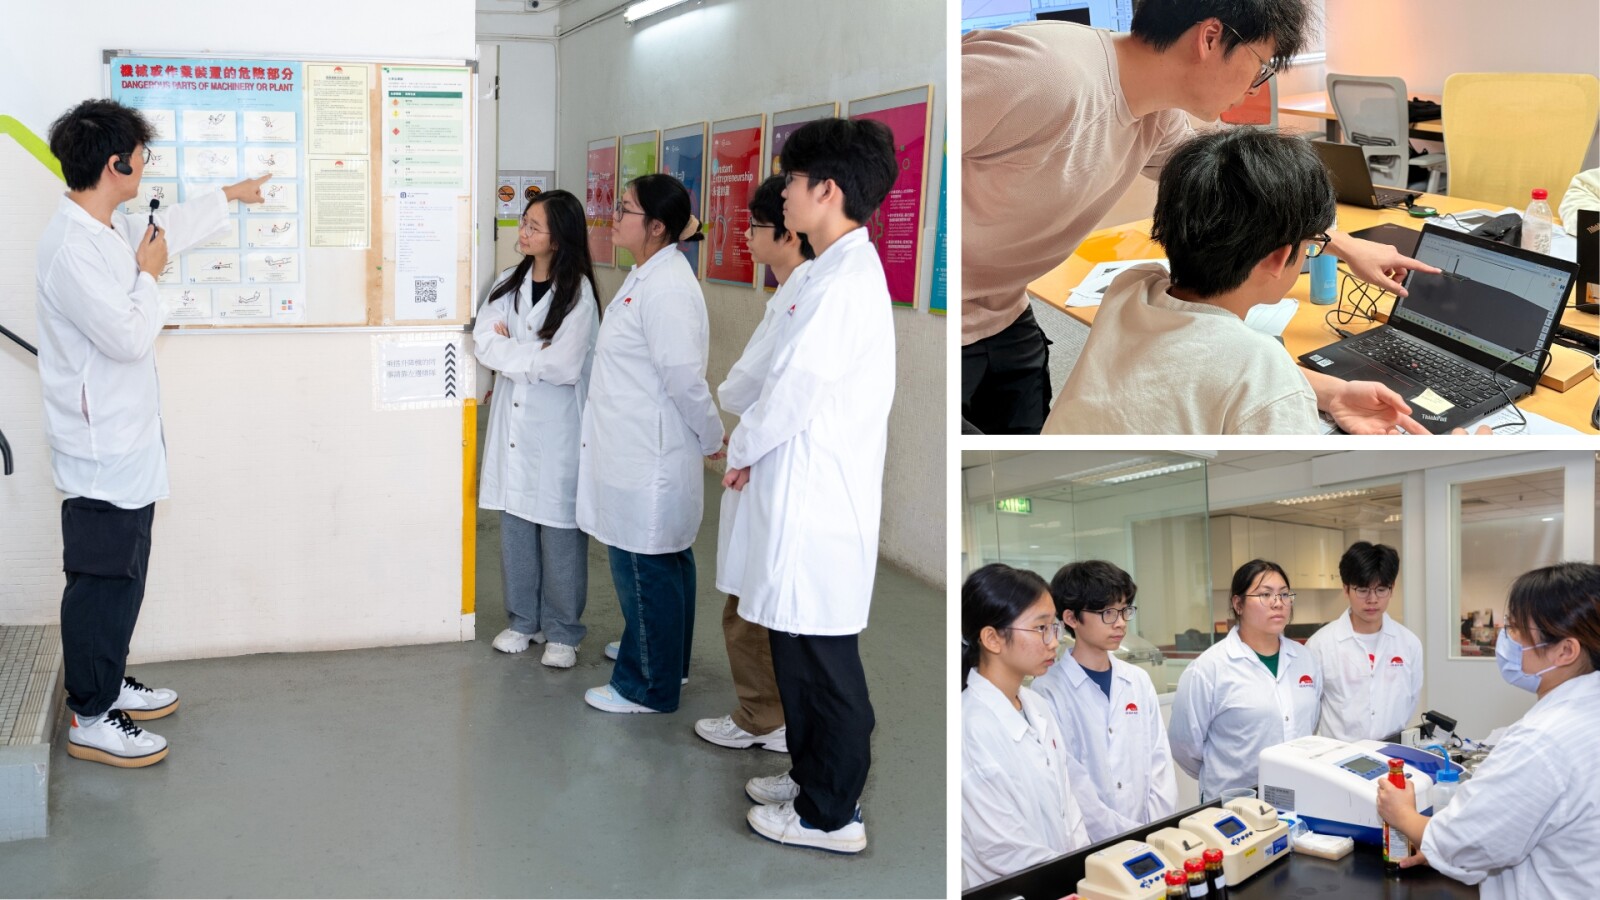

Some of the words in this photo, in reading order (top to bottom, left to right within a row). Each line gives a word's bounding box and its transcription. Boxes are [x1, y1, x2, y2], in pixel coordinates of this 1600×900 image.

[119, 64, 294, 80] 機械或作業裝置的危險部分
[121, 80, 171, 89] DANGEROUS
[172, 81, 197, 90] PARTS
[198, 82, 209, 91] OF
[210, 82, 255, 91] MACHINERY
[256, 83, 268, 91] OR
[269, 83, 294, 92] PLANT
[1421, 413, 1447, 423] ThinkPad
